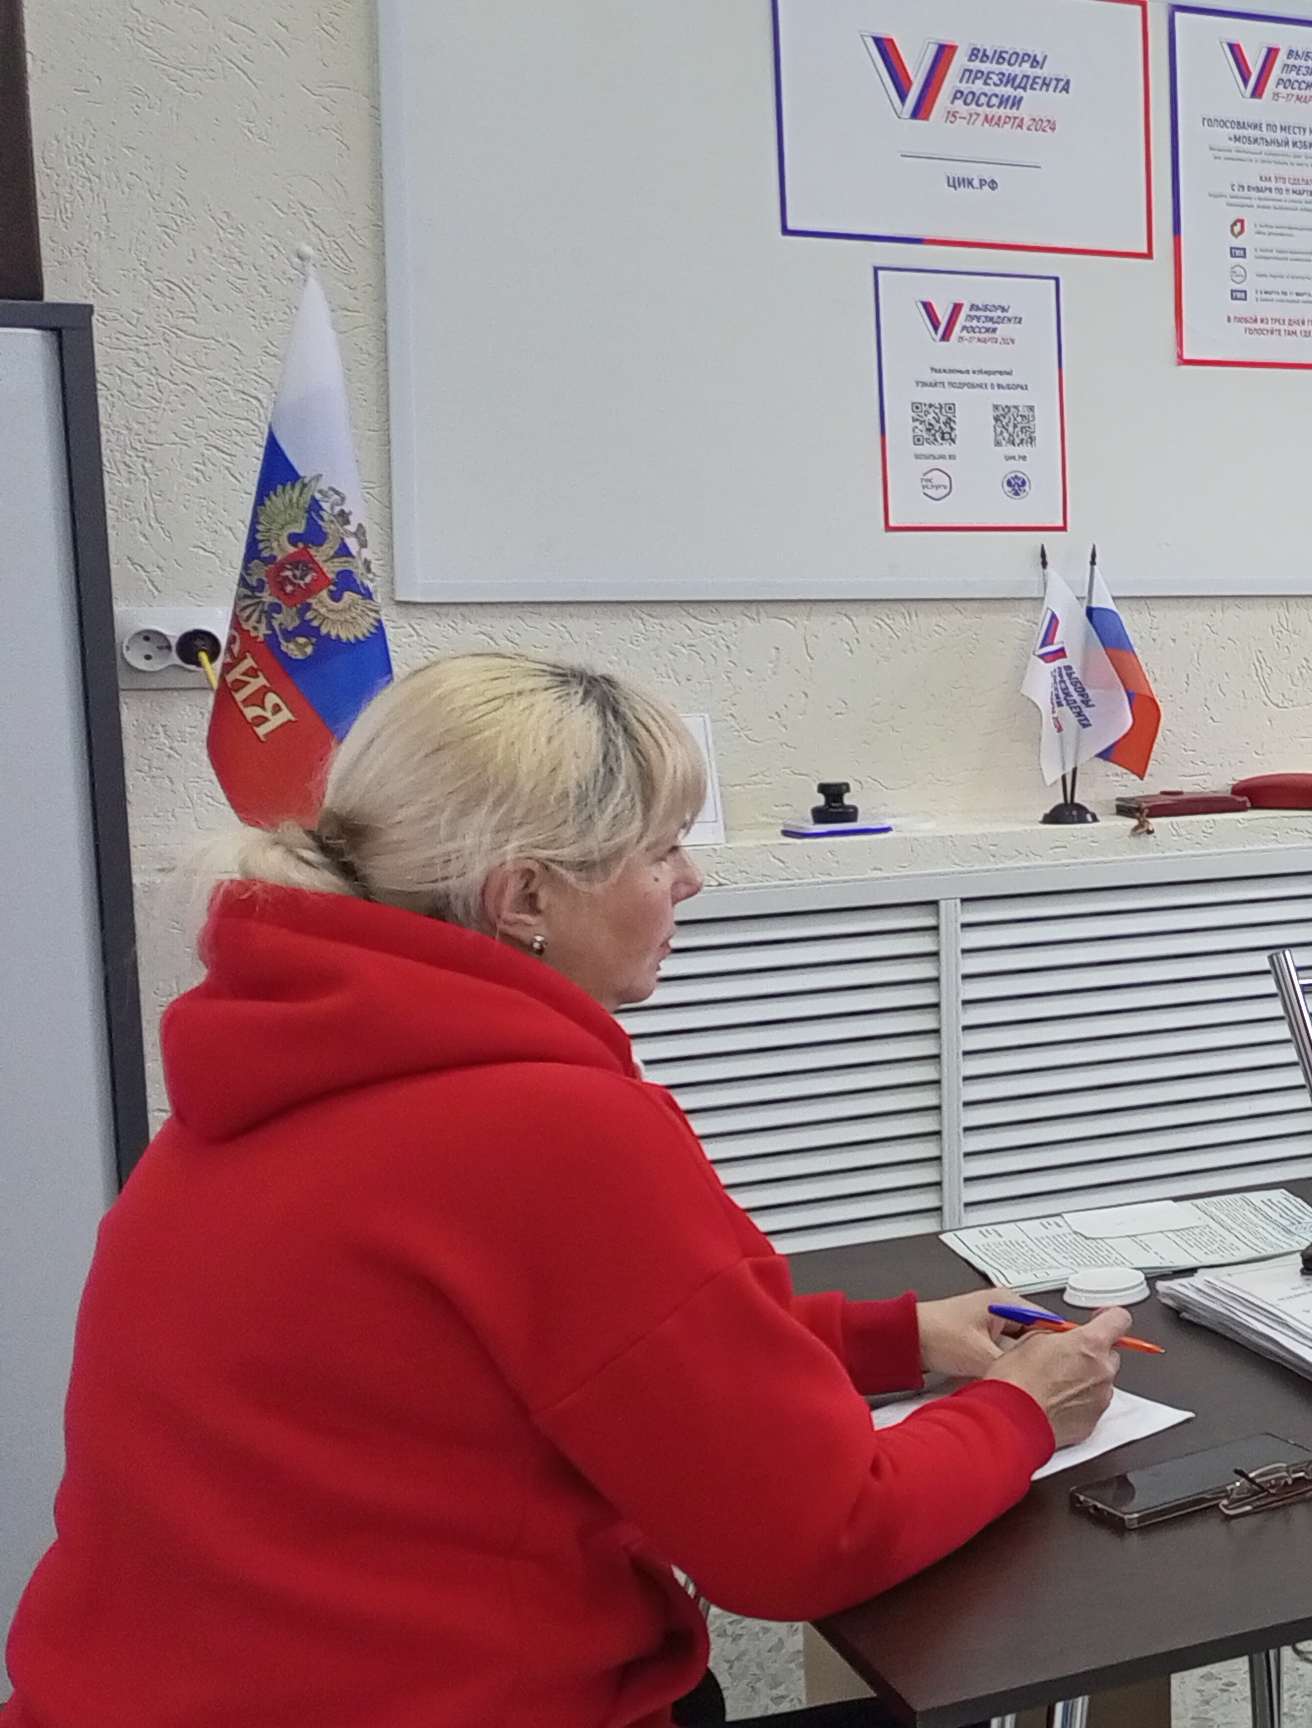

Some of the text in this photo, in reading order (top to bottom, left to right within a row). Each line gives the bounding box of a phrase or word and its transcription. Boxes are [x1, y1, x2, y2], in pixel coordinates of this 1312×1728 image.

[967, 47, 1048, 70] ВЫБОРЫ
[959, 68, 1072, 95] ПРЕЗИДЕНТА
[949, 89, 1025, 112] РОССИИ
[982, 114, 1025, 131] МАРТА
[1026, 118, 1057, 133] 2024
[1202, 116, 1264, 132] ГОЛОСОВАНИЕ
[1266, 123, 1278, 134] ПО
[1280, 124, 1307, 137] МЕСТУ
[946, 174, 999, 191] ЦИК.РФ
[968, 303, 1011, 314] ВЫБОРЫ
[965, 314, 1023, 325] ПРЕЗИДЕНТА
[960, 325, 998, 335] РОССИИ
[1063, 664, 1096, 709] ВЫБОРЫ
